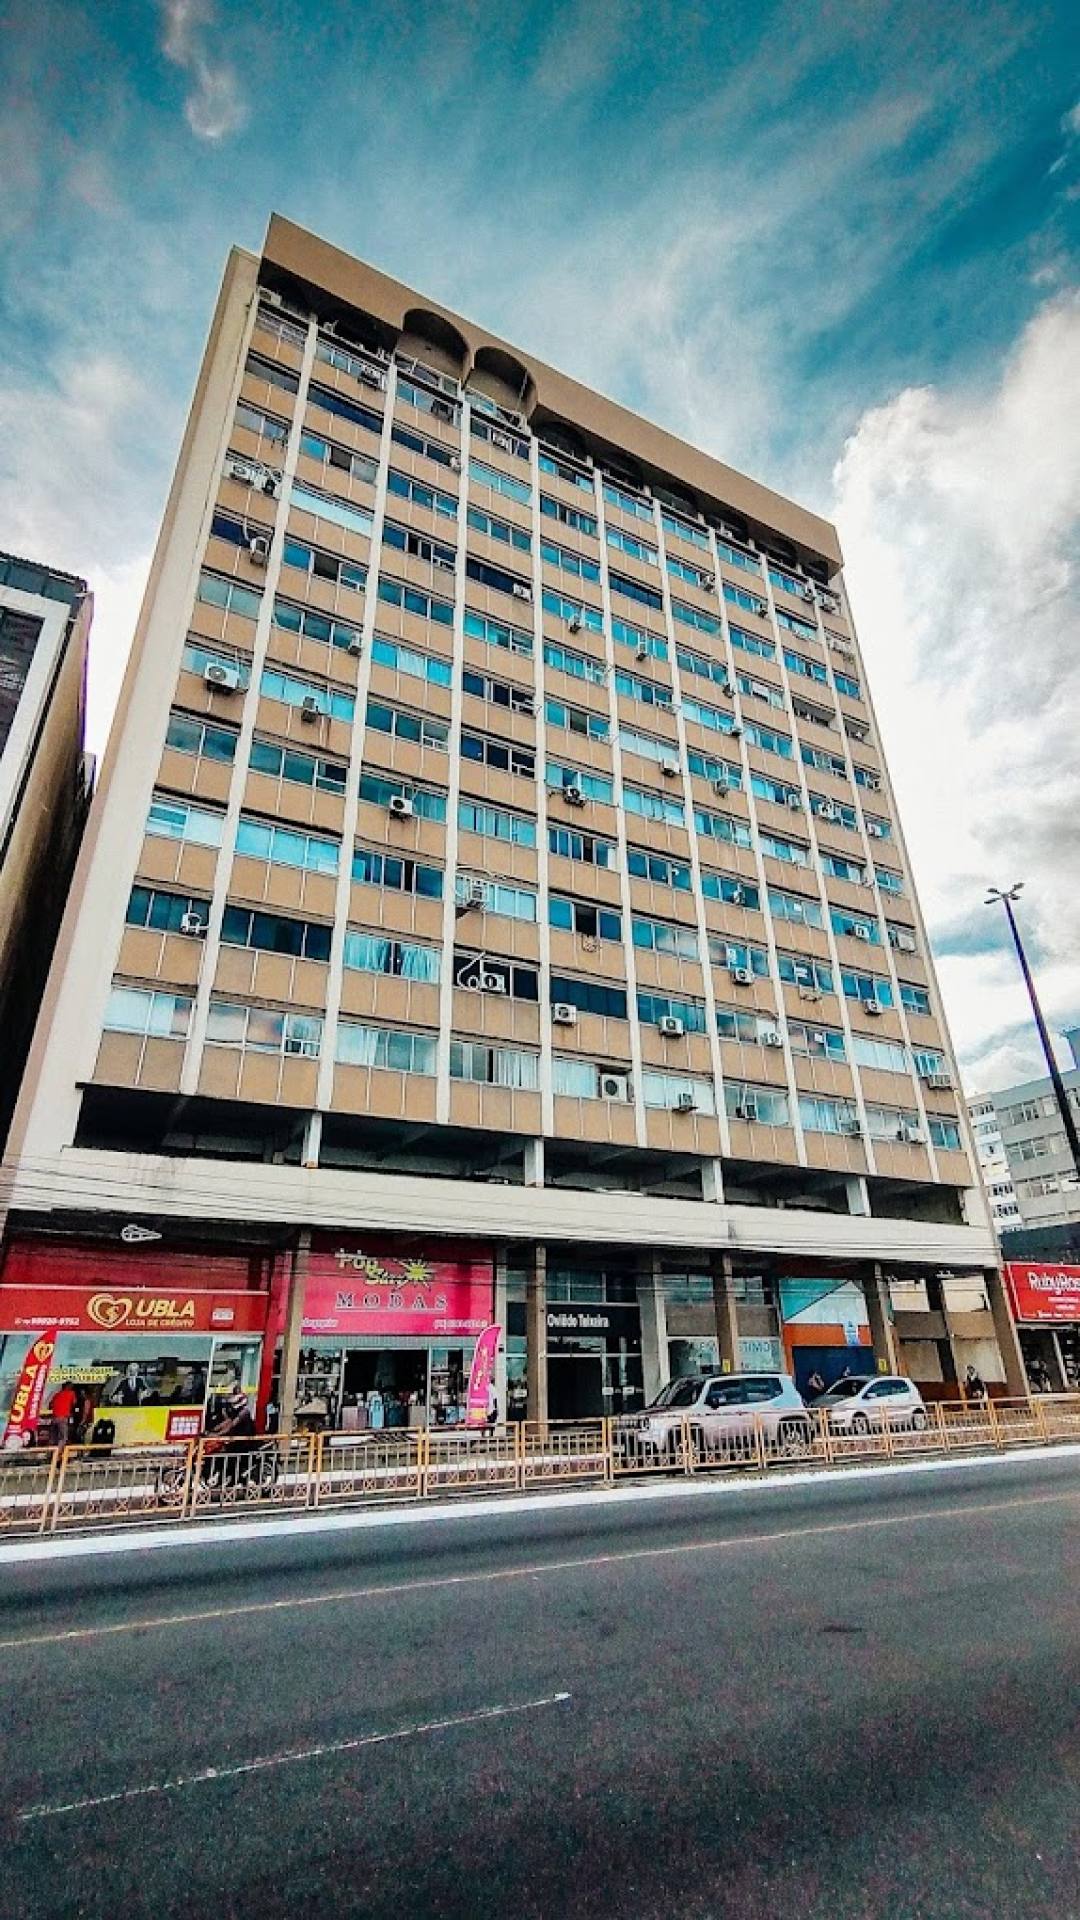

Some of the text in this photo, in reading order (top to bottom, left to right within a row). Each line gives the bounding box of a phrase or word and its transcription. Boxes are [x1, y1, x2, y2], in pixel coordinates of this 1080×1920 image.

[136, 1299, 196, 1318] UBLA
[336, 1290, 448, 1310] MODAS
[125, 1319, 146, 1327] LOJA
[148, 1319, 159, 1327] DE
[10, 1364, 39, 1423] UBLA
